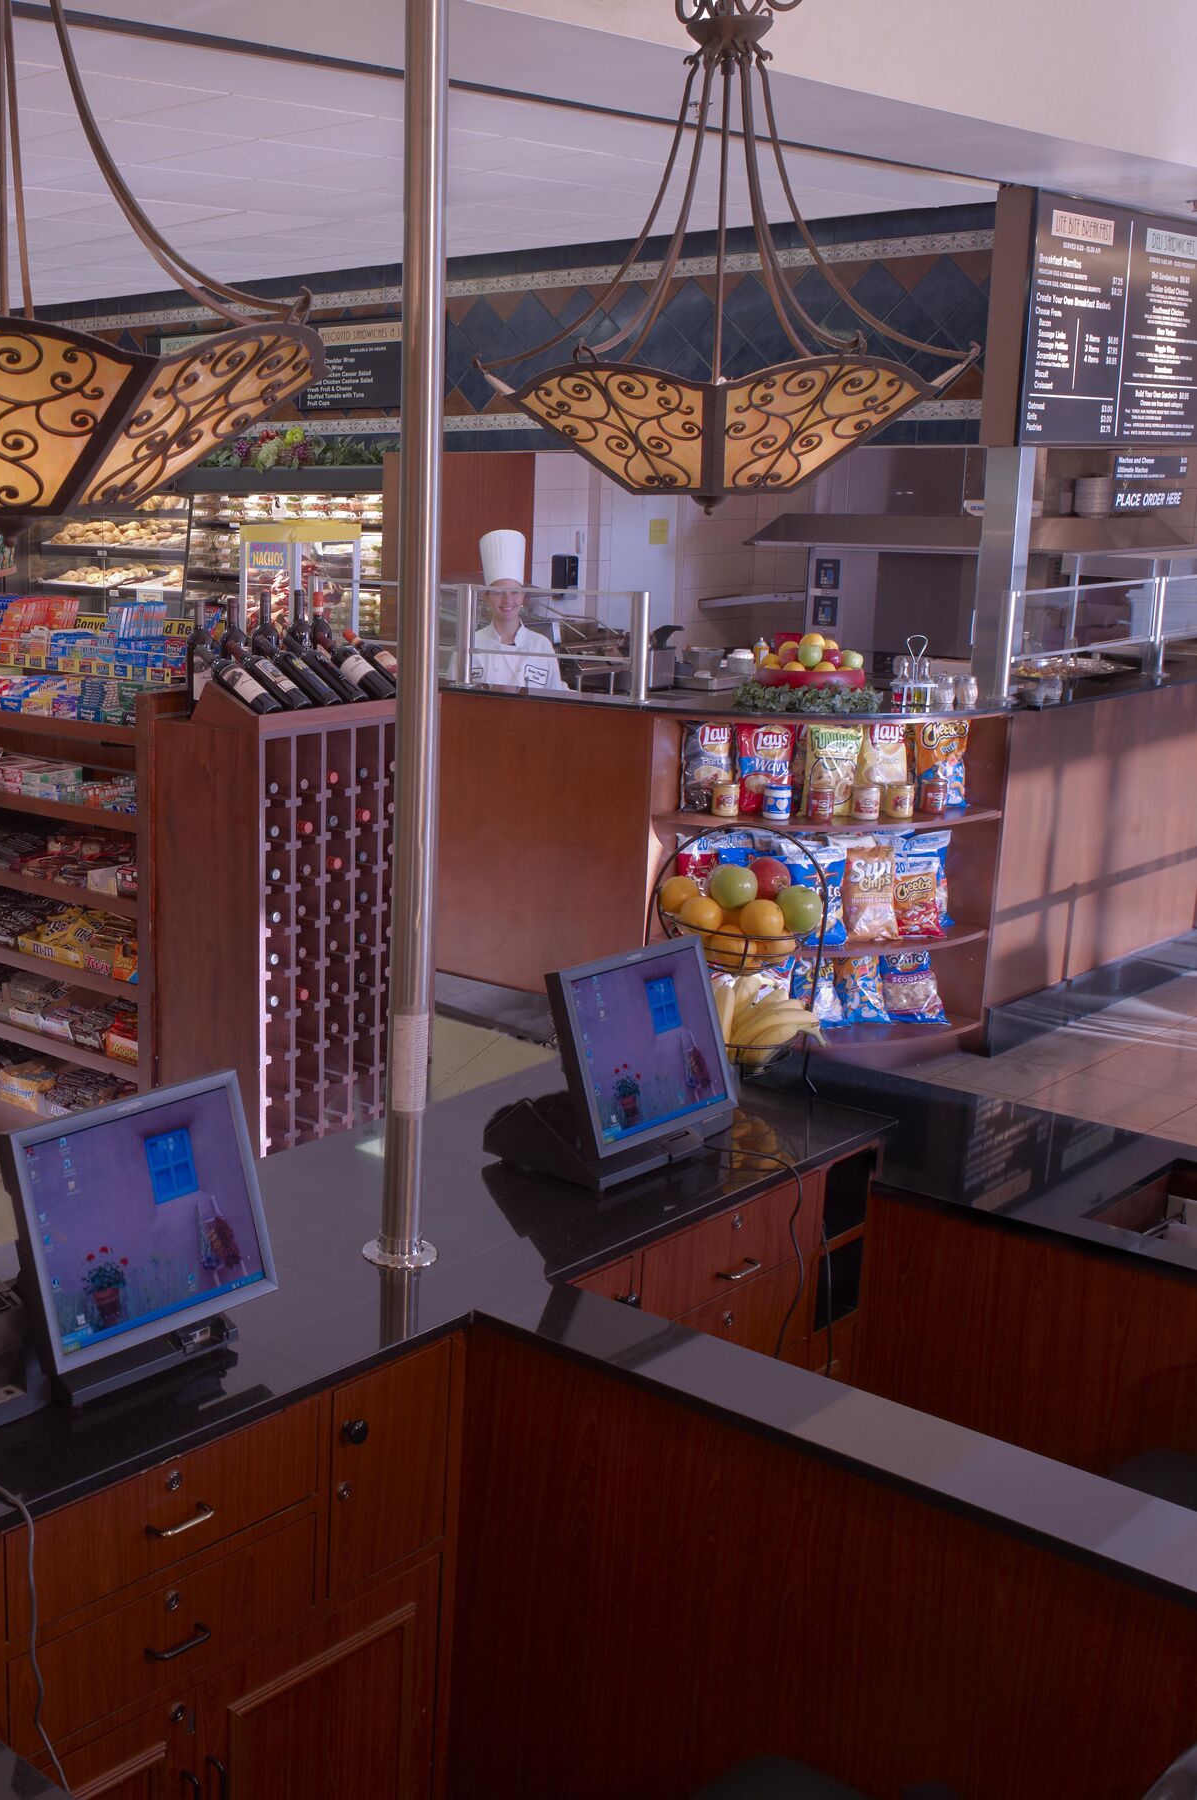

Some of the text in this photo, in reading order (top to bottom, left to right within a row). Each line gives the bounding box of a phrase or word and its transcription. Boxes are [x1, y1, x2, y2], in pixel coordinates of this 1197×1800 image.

[1068, 217, 1080, 235] BITE
[1083, 220, 1112, 240] BREAKFAST
[1039, 253, 1082, 269] Breakfast Burritos
[1036, 292, 1095, 308] Create Your Own Breakfast
[1035, 306, 1050, 315] Choose
[1039, 318, 1051, 326] Bacon
[353, 328, 387, 340] SANDWICHES
[1038, 329, 1055, 339] Sausage
[1037, 340, 1054, 350] Sausage
[1035, 370, 1049, 378] Biscuit
[1034, 380, 1053, 389] Croissant
[1028, 401, 1045, 410] Oatmeal
[1027, 412, 1037, 420] Grits
[1026, 423, 1042, 431] Pastries
[1116, 492, 1182, 506] PLACE ORDER HERE
[252, 552, 284, 566] NACHOS
[756, 732, 789, 750] Lay's
[922, 720, 968, 748] Cheetos
[754, 758, 789, 776] Wavy
[850, 860, 892, 882] Sun
[858, 874, 892, 892] Chips
[894, 877, 932, 901] Cheetos
[85, 955, 111, 973] Twix
